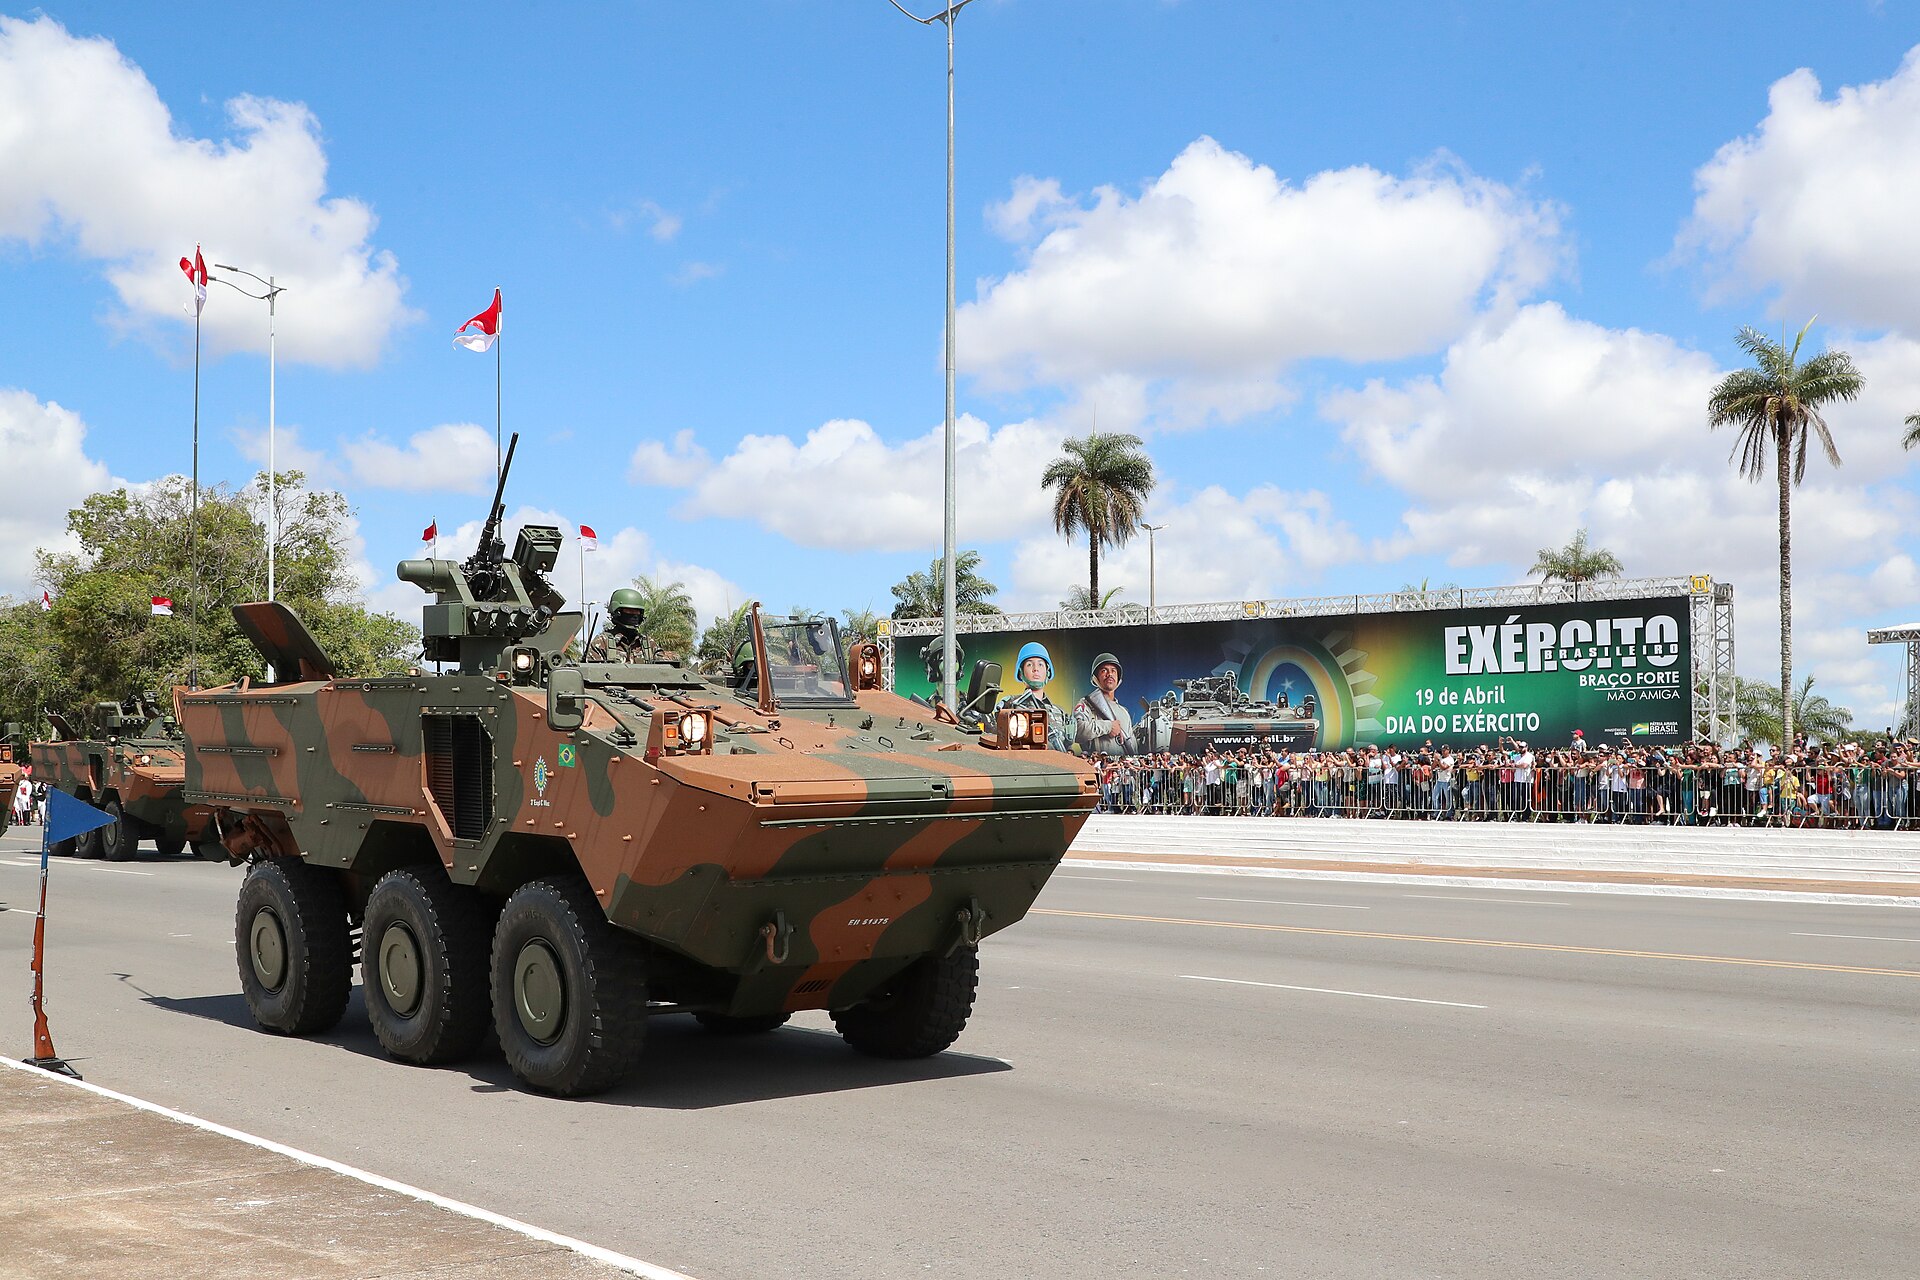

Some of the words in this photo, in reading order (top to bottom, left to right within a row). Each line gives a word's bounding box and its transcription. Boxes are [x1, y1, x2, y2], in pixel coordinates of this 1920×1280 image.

[1444, 614, 1679, 674] EXÉRCITO
[1544, 643, 1679, 660] BRASILEIRO
[1579, 672, 1632, 688] BRAÇO
[1636, 671, 1680, 685] FORTE
[1415, 688, 1434, 706] 19
[1438, 686, 1459, 706] de
[1463, 685, 1506, 705] Abril
[1607, 689, 1637, 701] MÃO
[1639, 689, 1680, 700] AMIGA
[1386, 715, 1417, 734] DIA
[1421, 714, 1447, 733] DO
[1452, 708, 1540, 733] EXÉRCITO
